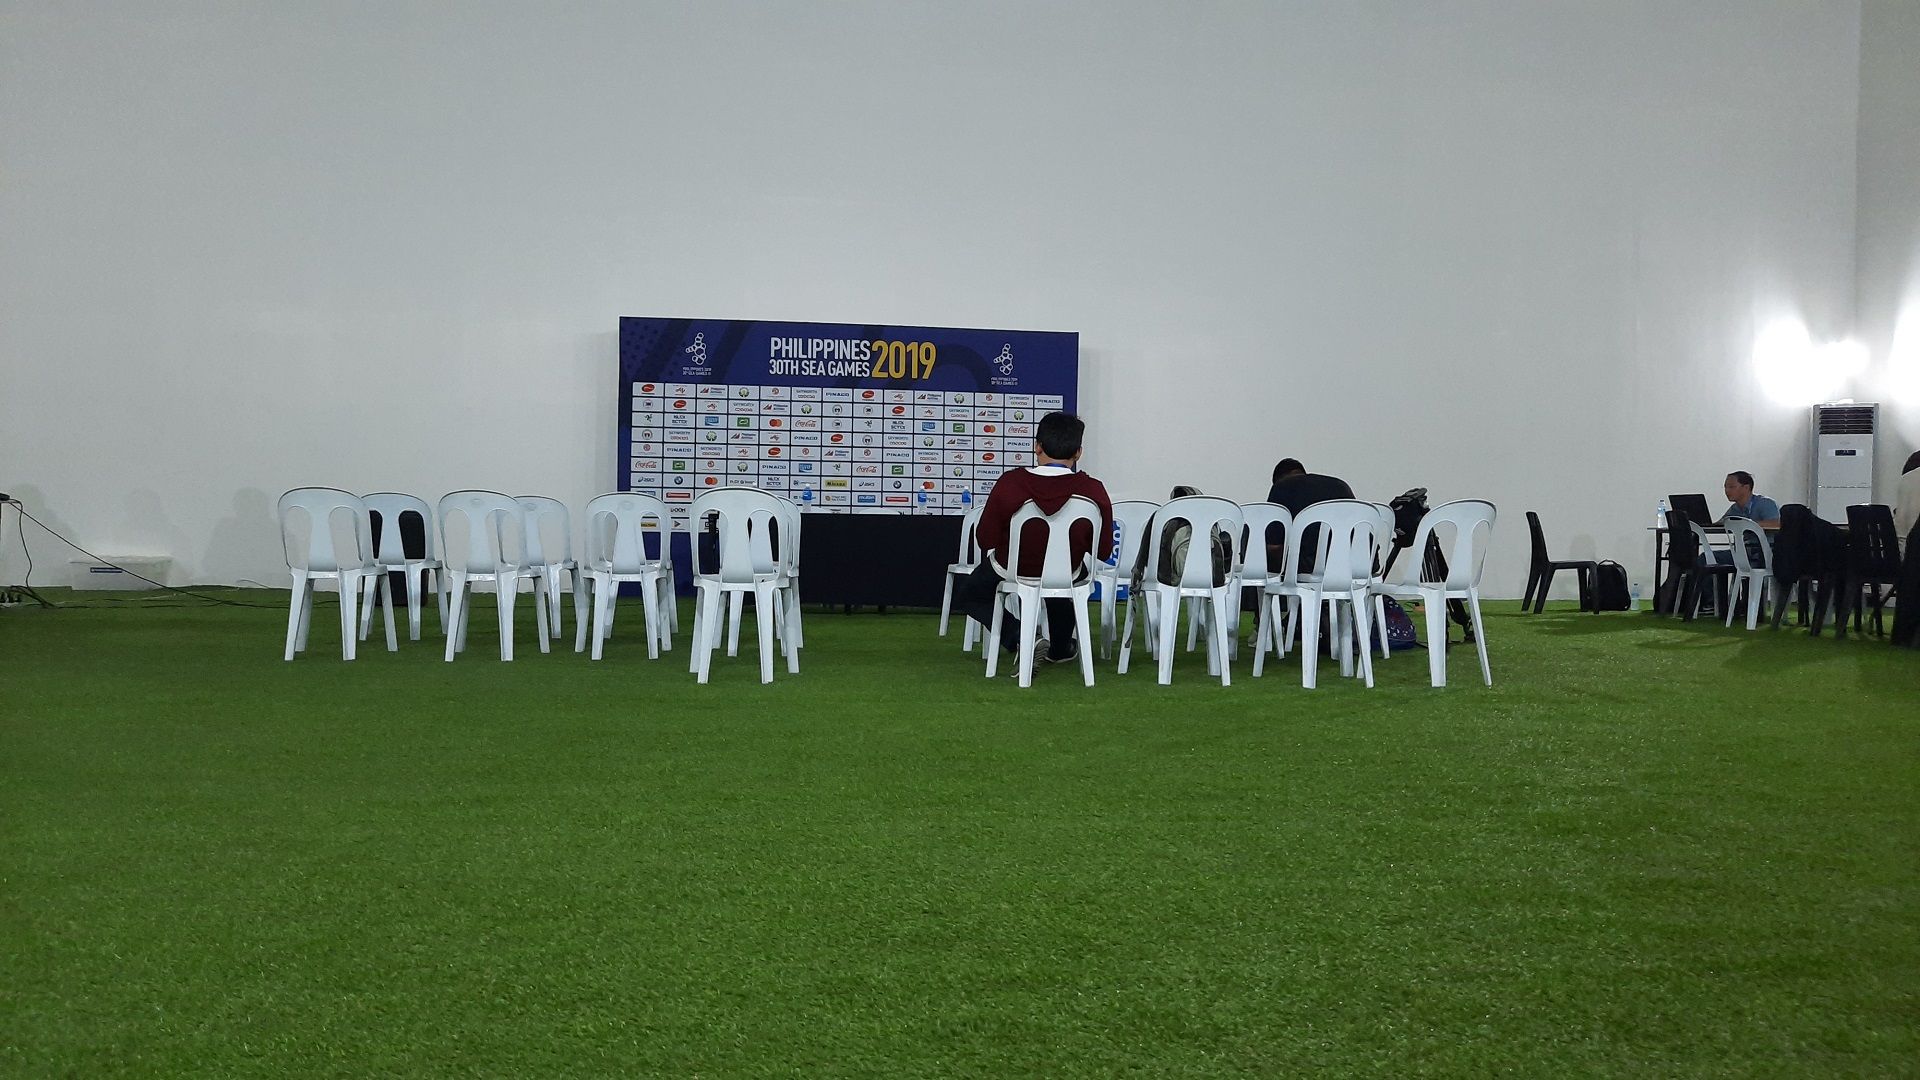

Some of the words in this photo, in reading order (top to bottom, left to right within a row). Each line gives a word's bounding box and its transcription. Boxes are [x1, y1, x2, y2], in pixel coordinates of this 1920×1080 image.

[770, 336, 871, 361] PHILIPPINES
[871, 340, 936, 380] 2019
[769, 359, 799, 376] 30TH
[801, 360, 826, 376] SEA
[828, 361, 870, 378] GAMES
